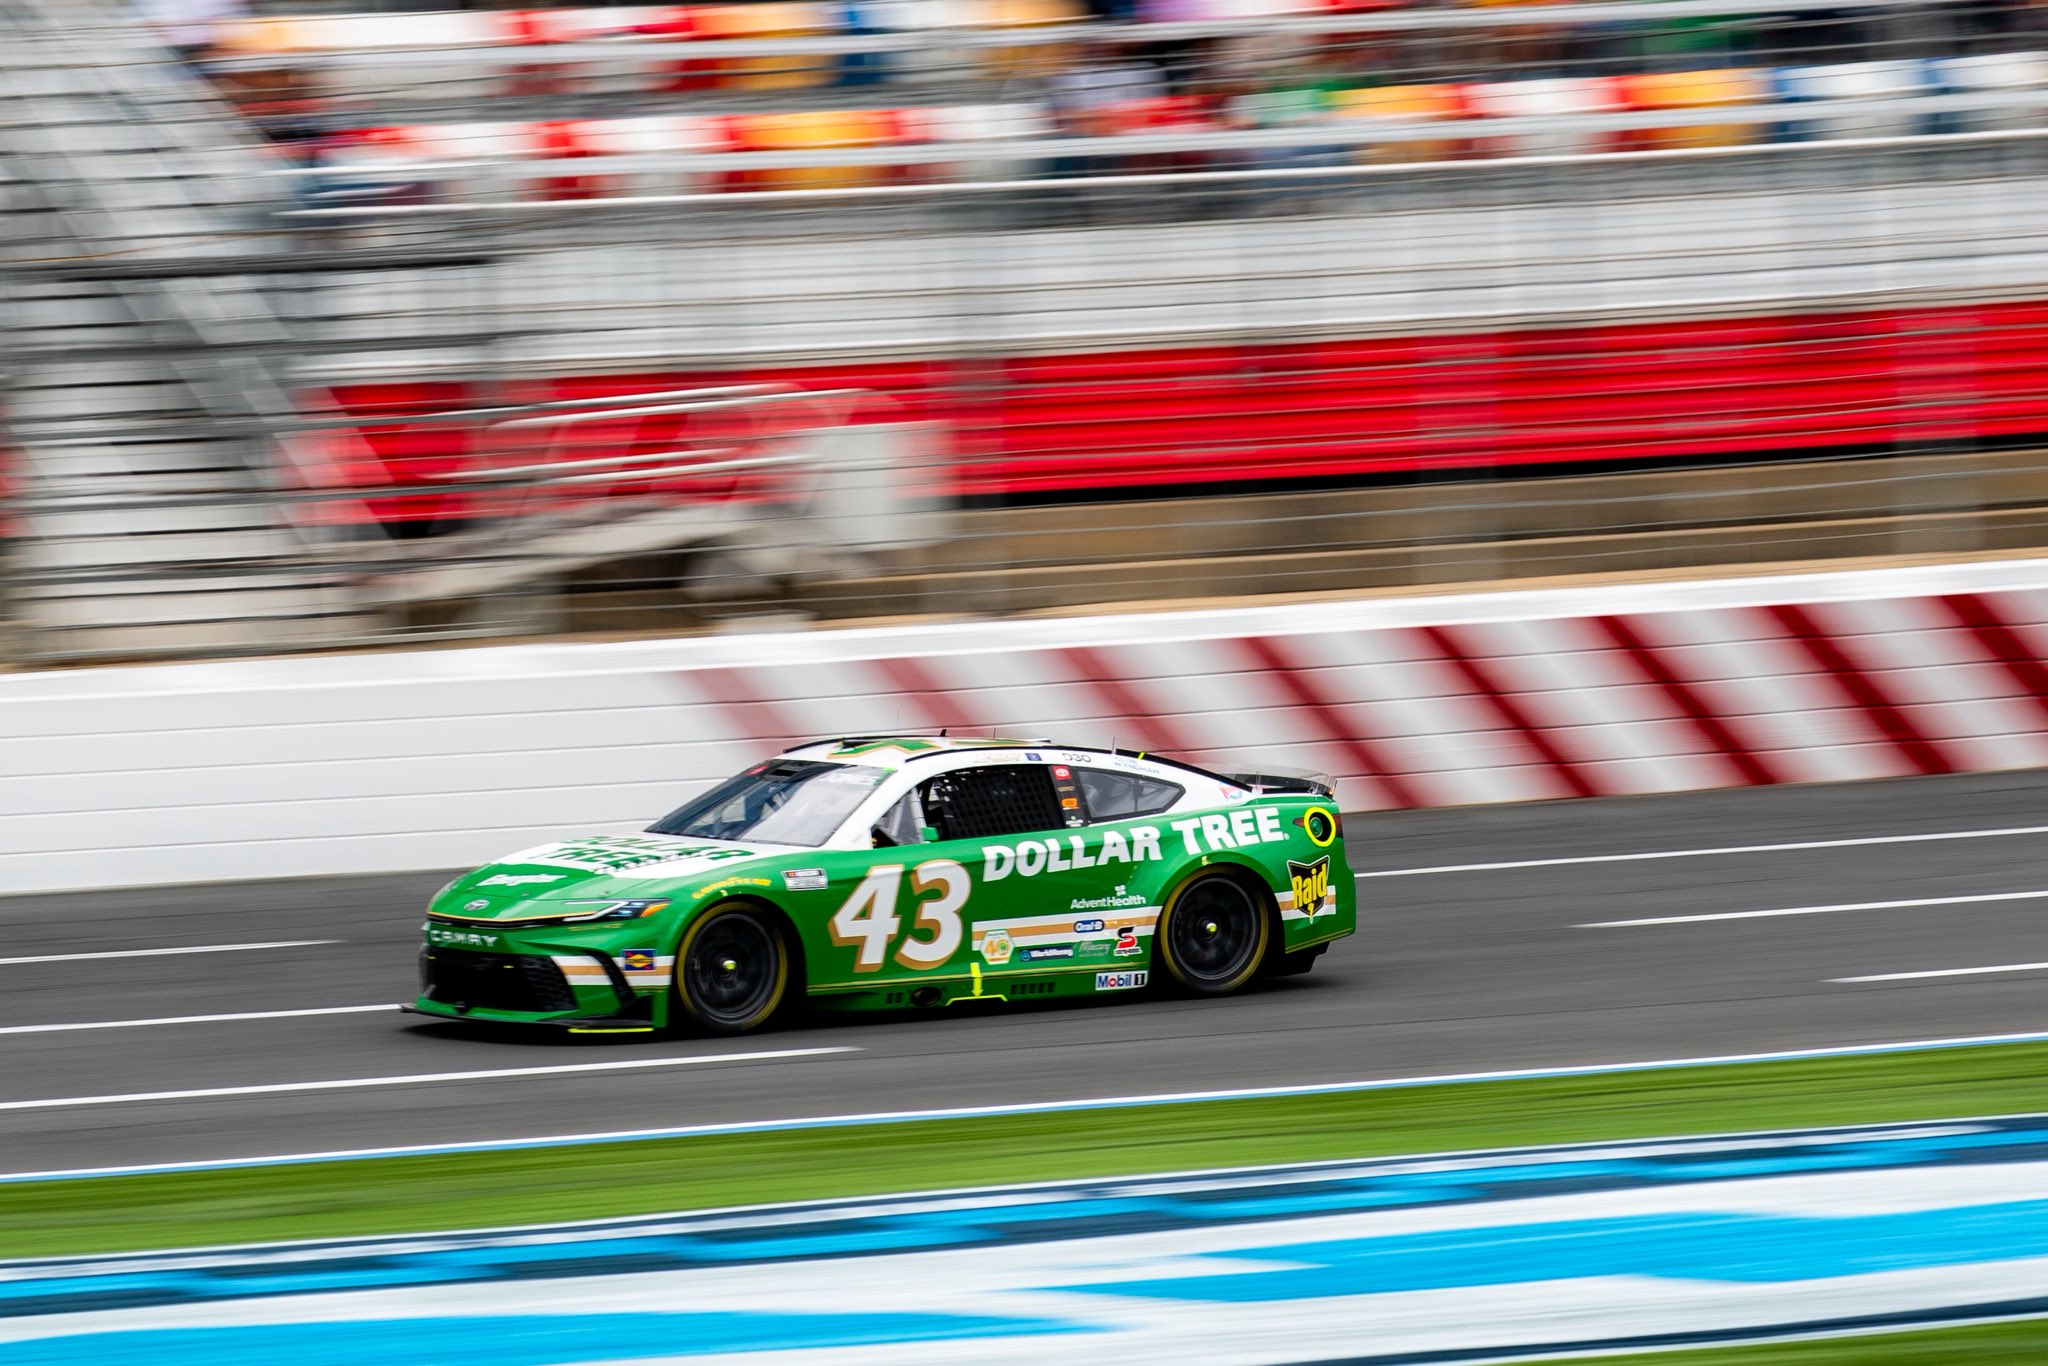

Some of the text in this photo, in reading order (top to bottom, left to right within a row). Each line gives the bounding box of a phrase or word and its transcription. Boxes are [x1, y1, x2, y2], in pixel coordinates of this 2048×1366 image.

[982, 807, 1285, 882] DOLLAR TREE
[1070, 895, 1146, 909] AdventHealth
[1292, 863, 1328, 911] Raid
[828, 859, 971, 973] 43
[1076, 921, 1103, 932] Oral-B
[1097, 974, 1132, 988] Mobil
